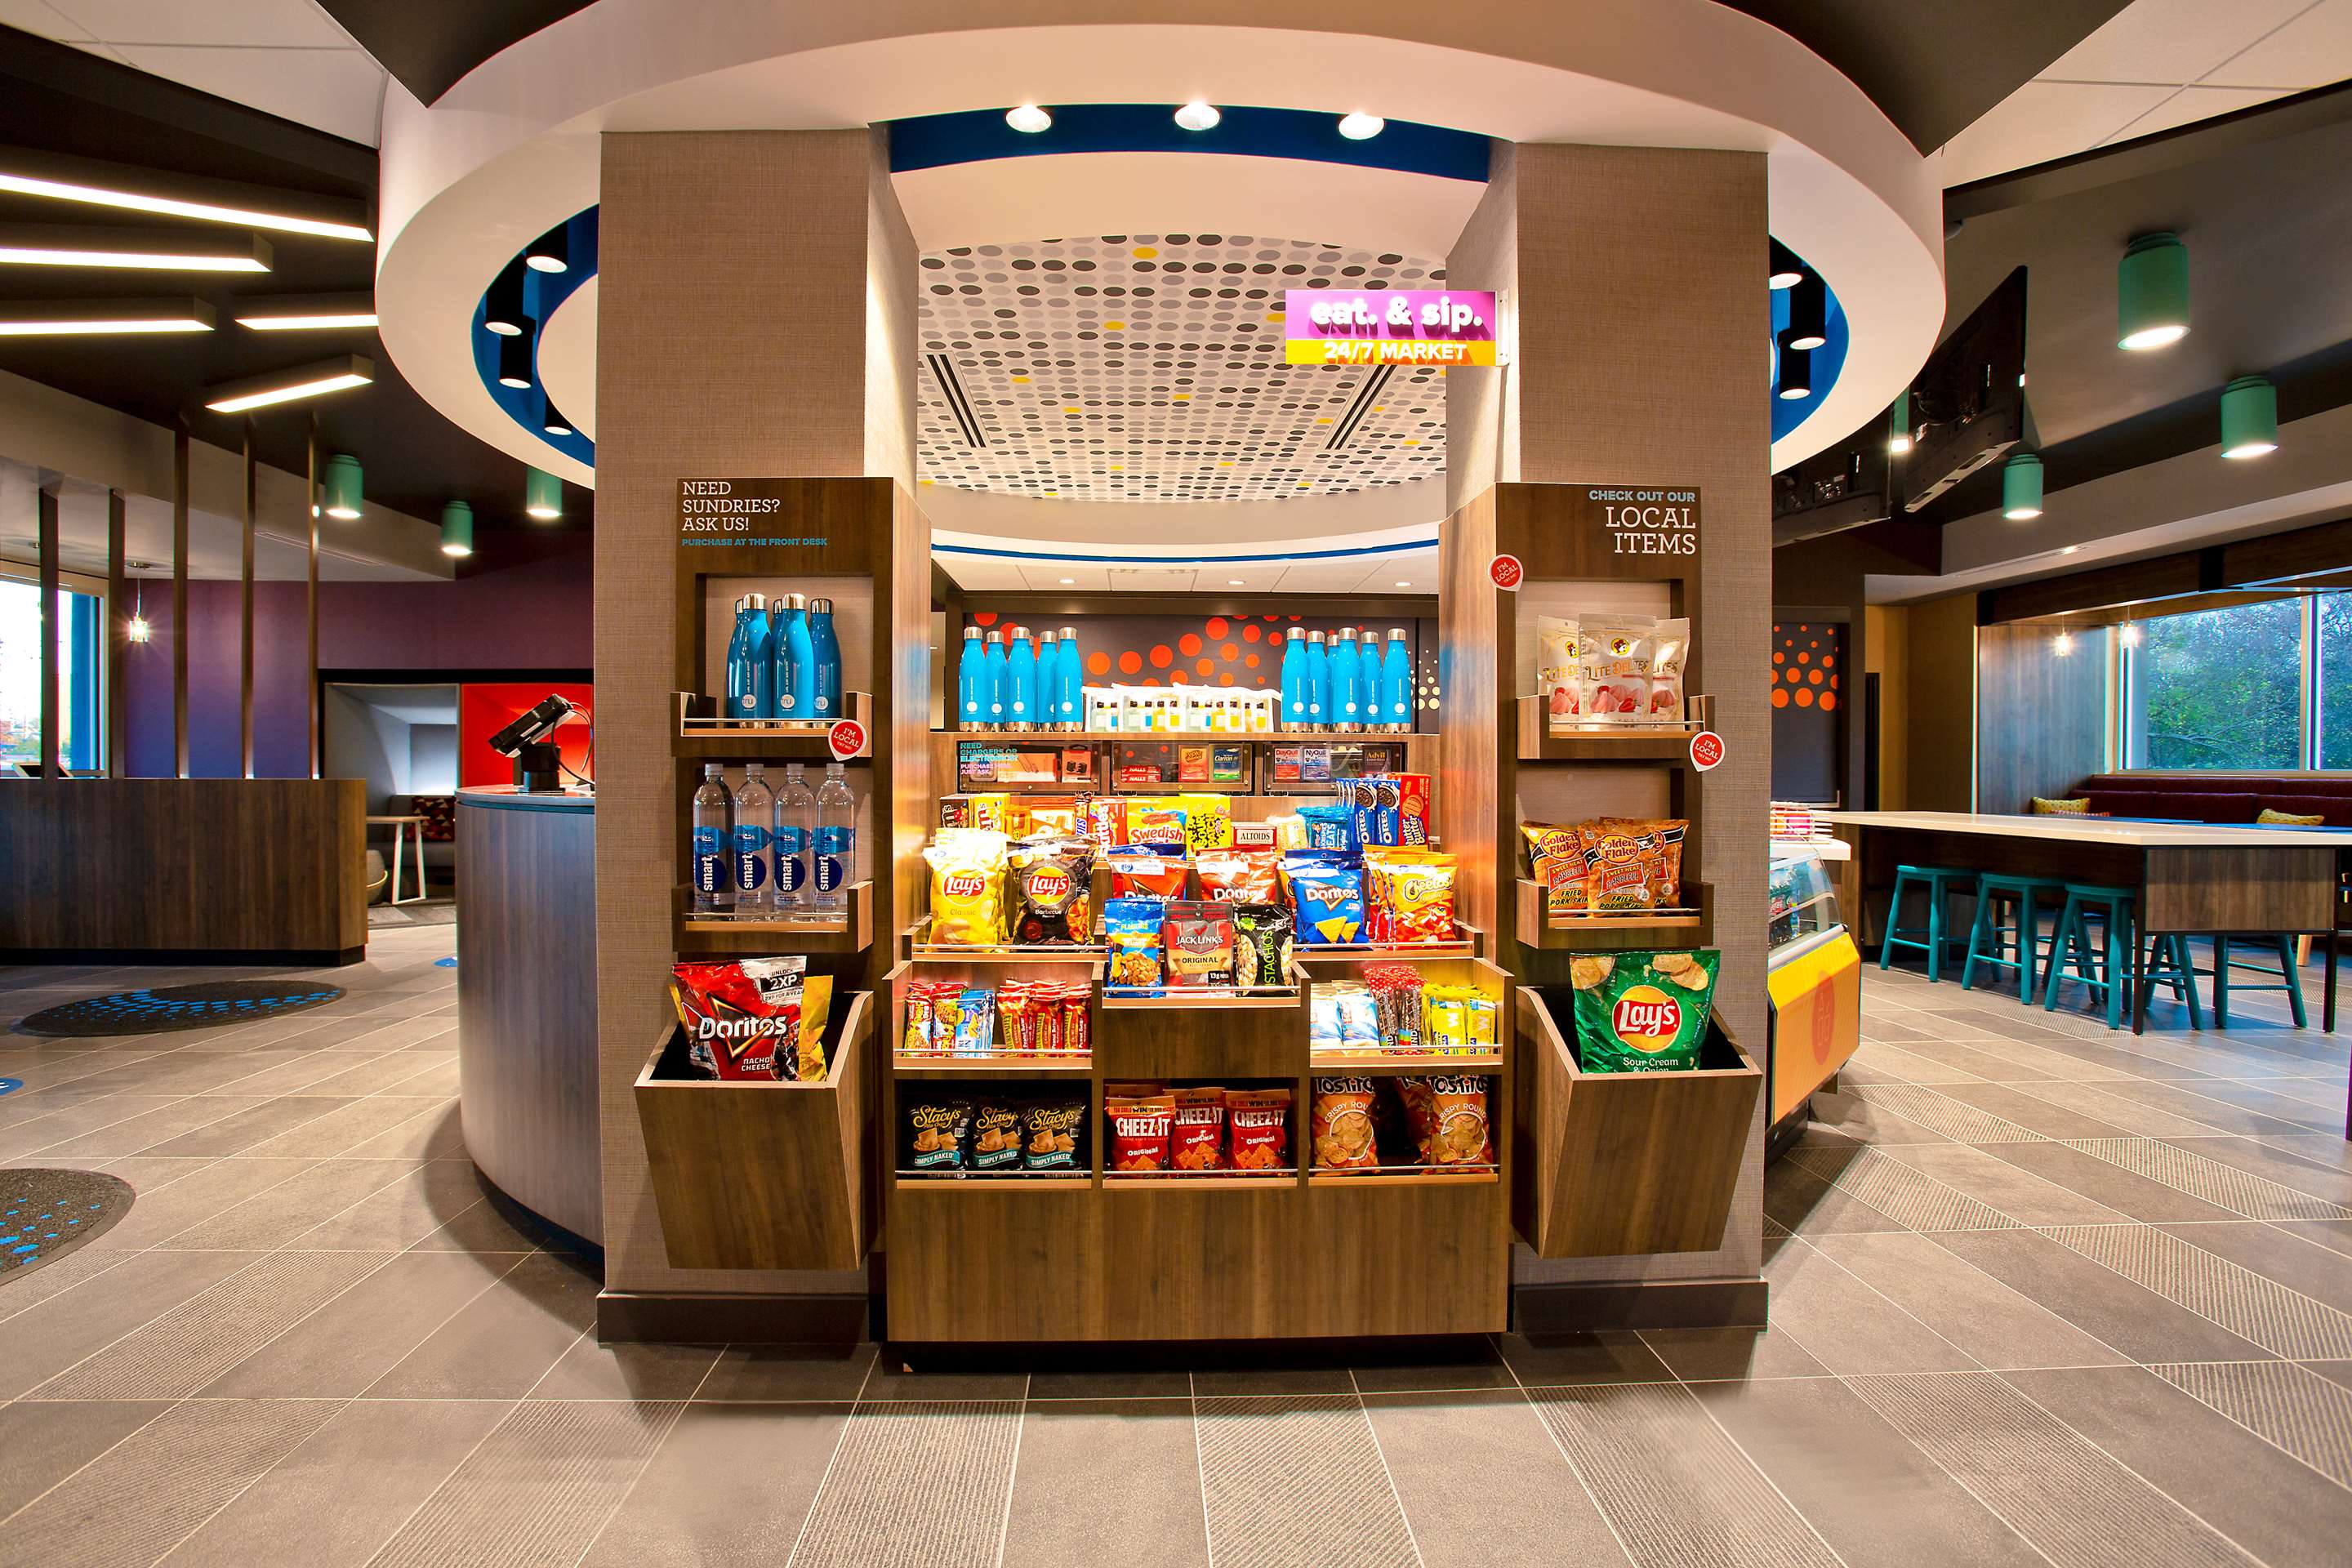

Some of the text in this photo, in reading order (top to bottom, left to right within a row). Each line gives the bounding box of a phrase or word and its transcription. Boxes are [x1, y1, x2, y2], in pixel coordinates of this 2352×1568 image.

[1310, 296, 1483, 333] eat. & sip.
[1324, 341, 1467, 360] 24/7 MARKET
[682, 482, 731, 495] NEED
[1589, 490, 1695, 502] CHECK OUT OUR
[682, 499, 781, 513] SUNDRIES?
[682, 517, 749, 531] ASK US!
[1606, 506, 1695, 529] LOCAL
[682, 538, 732, 546] PURCHASE
[803, 537, 827, 546] DESK
[1614, 532, 1695, 555] ITEMS
[1495, 564, 1518, 582] LOCAL
[1497, 562, 1509, 572] I'M
[834, 732, 859, 747] LOCAL
[843, 728, 856, 738] I'M
[1695, 743, 1718, 760] LOCAL
[1704, 739, 1716, 750] I'M
[1130, 826, 1183, 844] Swedish
[1359, 810, 1370, 844] OREO
[1381, 810, 1392, 844] OREO
[1241, 832, 1271, 840] ALTOIDS
[1543, 831, 1579, 847] Golden
[1550, 841, 1579, 855] Flake
[1605, 845, 1635, 858] Flake
[945, 876, 982, 897] Lay's
[1031, 875, 1067, 897] Lay's
[1176, 936, 1198, 945] JACK
[771, 968, 794, 977] UNLOCK
[770, 974, 798, 991] 2XP
[1619, 1001, 1676, 1037] Lay's
[699, 1015, 787, 1040] Doritos
[742, 1063, 771, 1071] CHEESE
[1623, 1057, 1679, 1067] Sour Cream
[913, 1105, 961, 1129] Stacy's
[1029, 1109, 1075, 1131] Stacy's
[1325, 1102, 1348, 1123] CRISPY
[1439, 1104, 1460, 1123] CRISPY
[978, 1152, 1018, 1165] SIMPLY NAKED
[1031, 1157, 1051, 1166] SIMPLY
